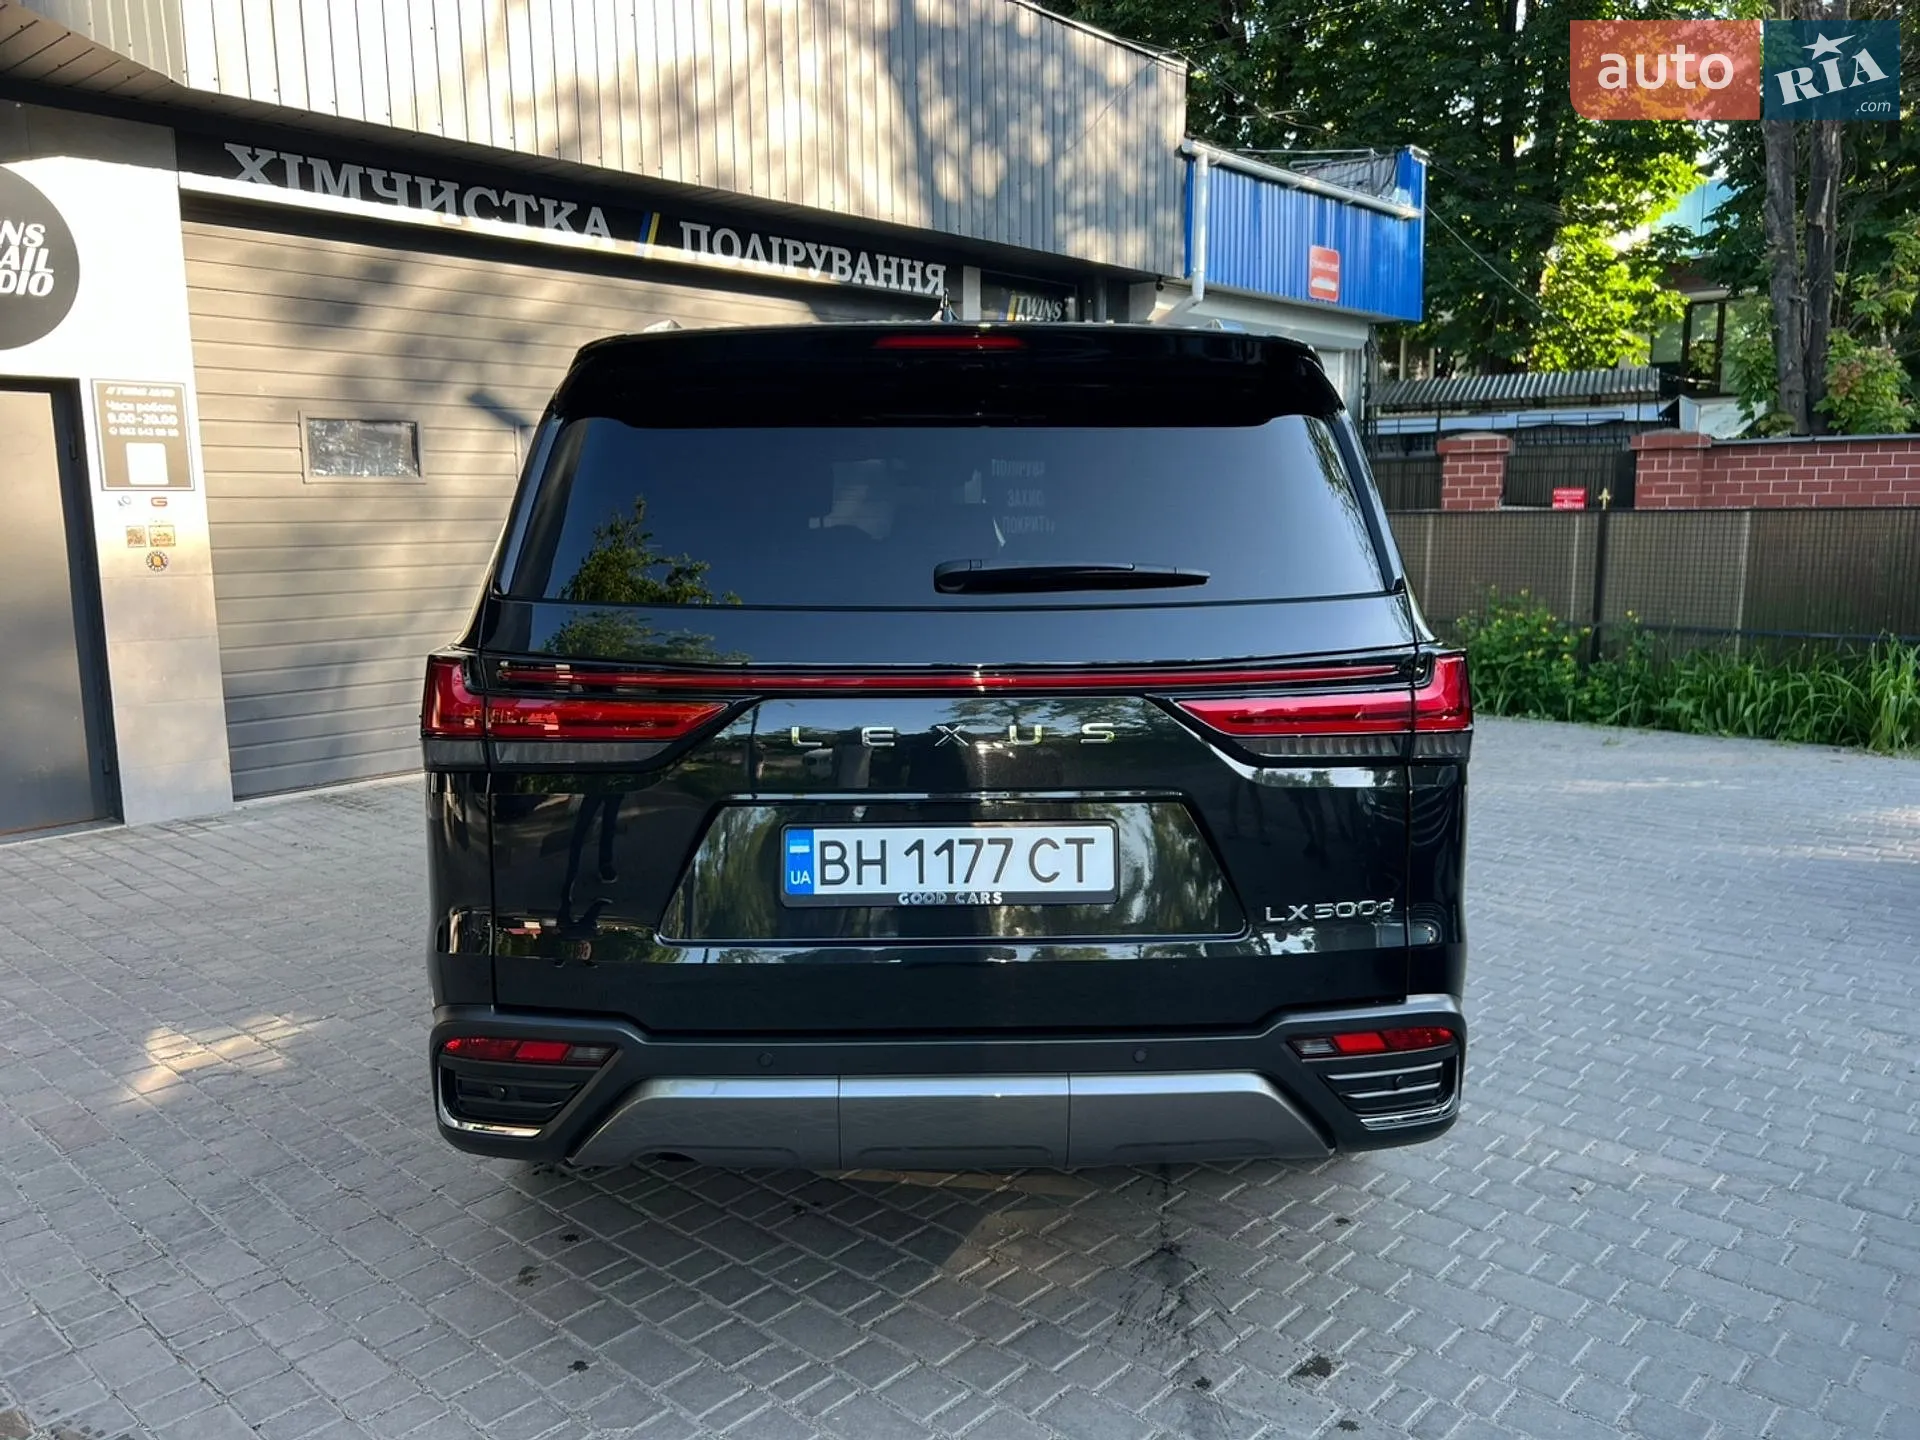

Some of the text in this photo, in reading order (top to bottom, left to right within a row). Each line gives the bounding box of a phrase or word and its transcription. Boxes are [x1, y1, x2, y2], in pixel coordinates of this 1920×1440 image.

[224, 142, 947, 296] ХІМЧИСТКА ПОЛІРУВАННЯ
[0, 220, 46, 248] NS
[1017, 295, 1062, 320] TWINS
[791, 722, 1115, 747] LEXUS
[819, 837, 1096, 886] BH 1177 CT
[790, 870, 812, 886] UA
[898, 891, 1003, 905] GOOD CARS
